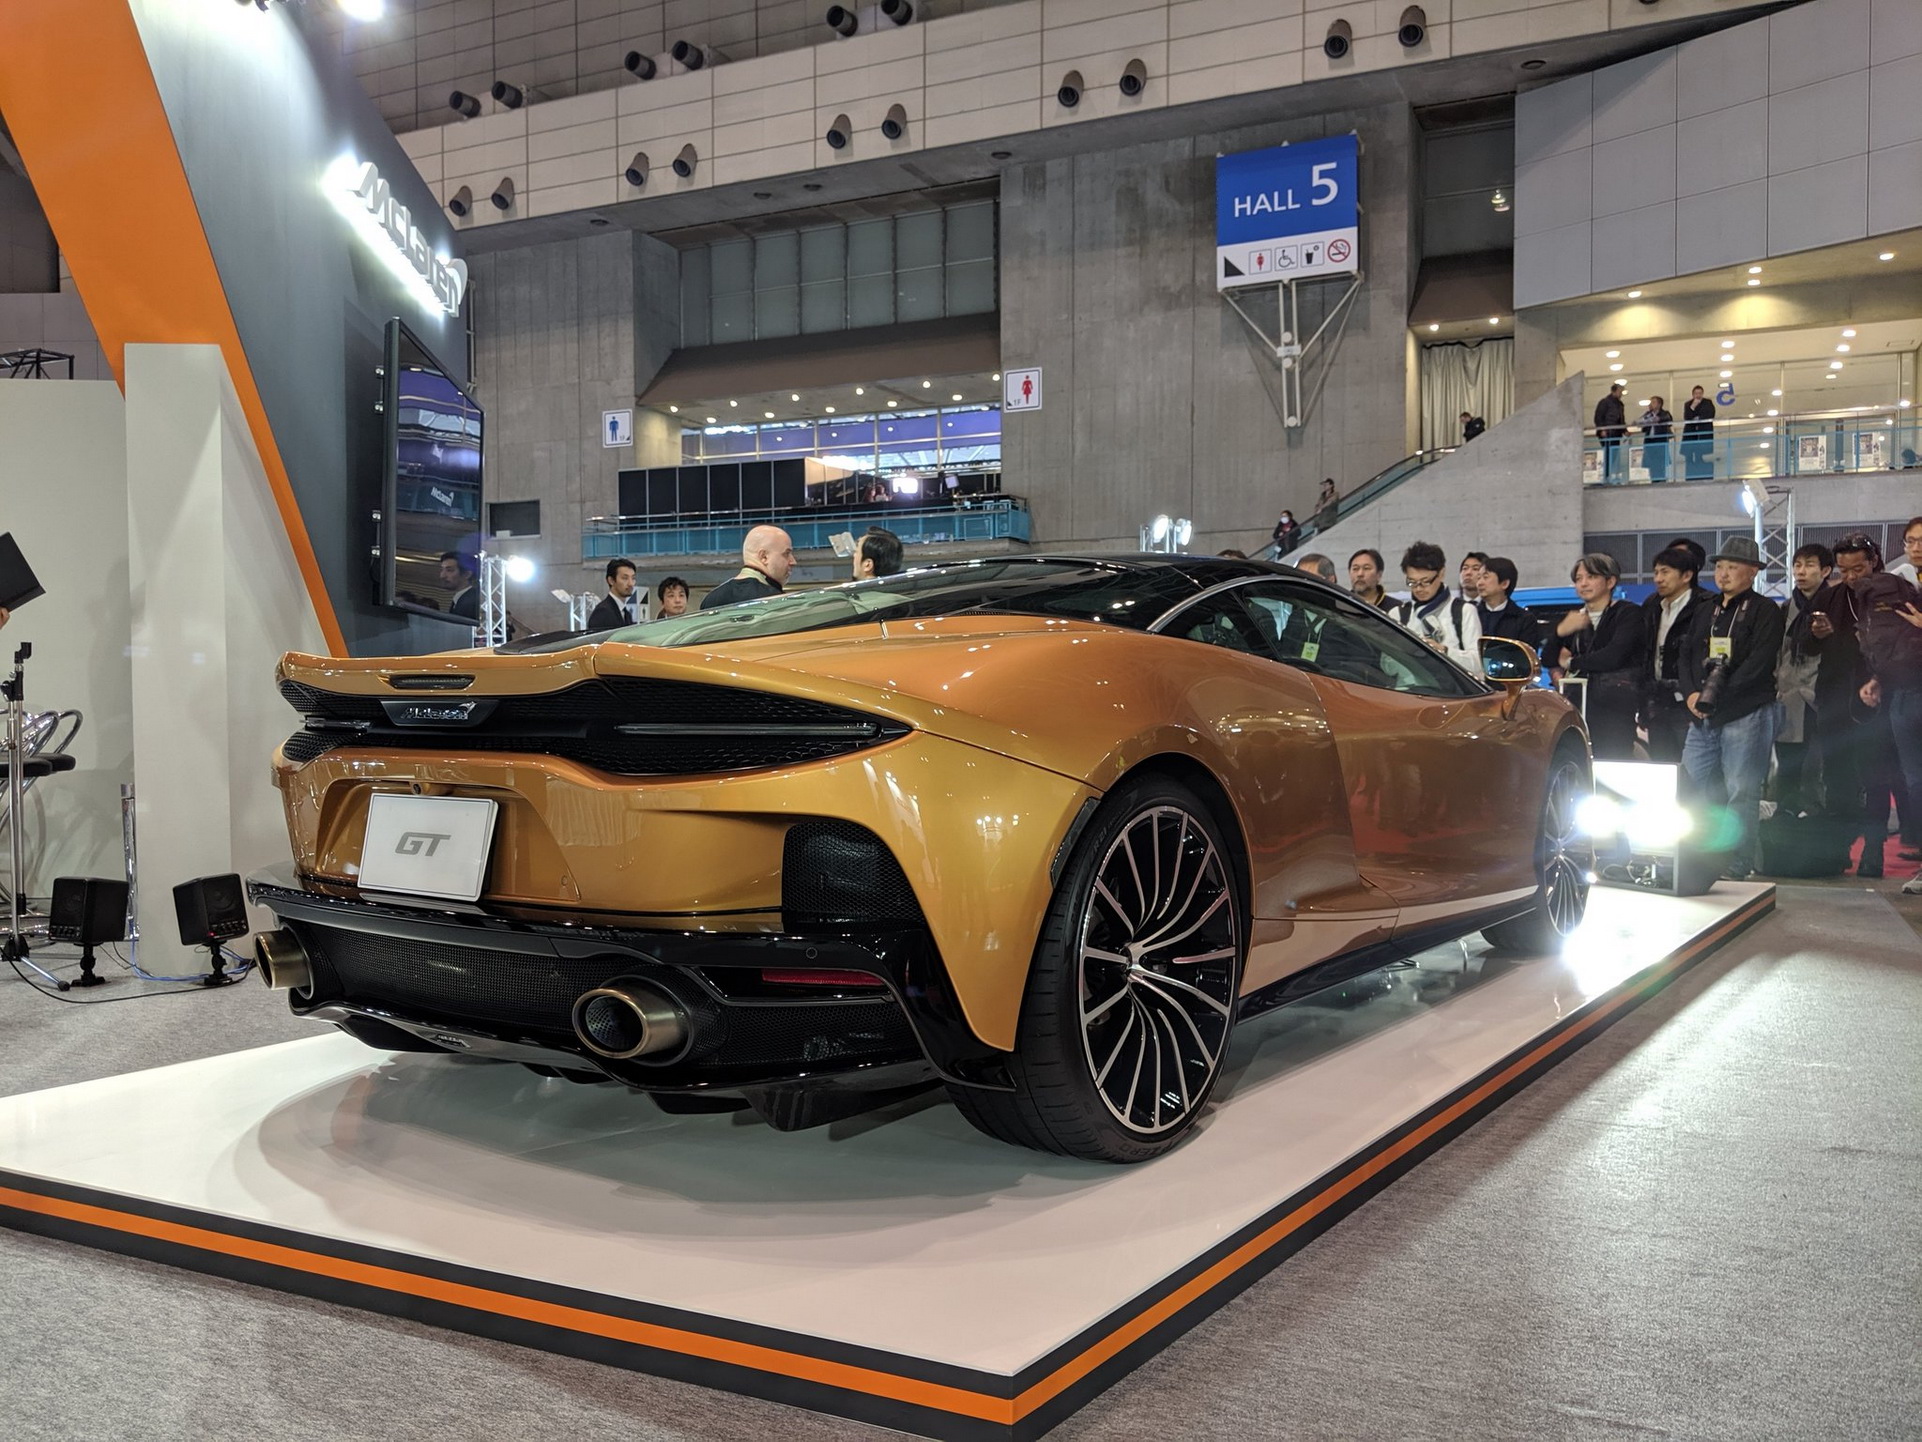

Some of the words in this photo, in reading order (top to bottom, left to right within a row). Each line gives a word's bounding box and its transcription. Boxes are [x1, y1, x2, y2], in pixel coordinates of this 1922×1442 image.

[1234, 189, 1300, 218] HALL
[1311, 162, 1338, 206] 5
[395, 832, 451, 857] GT
